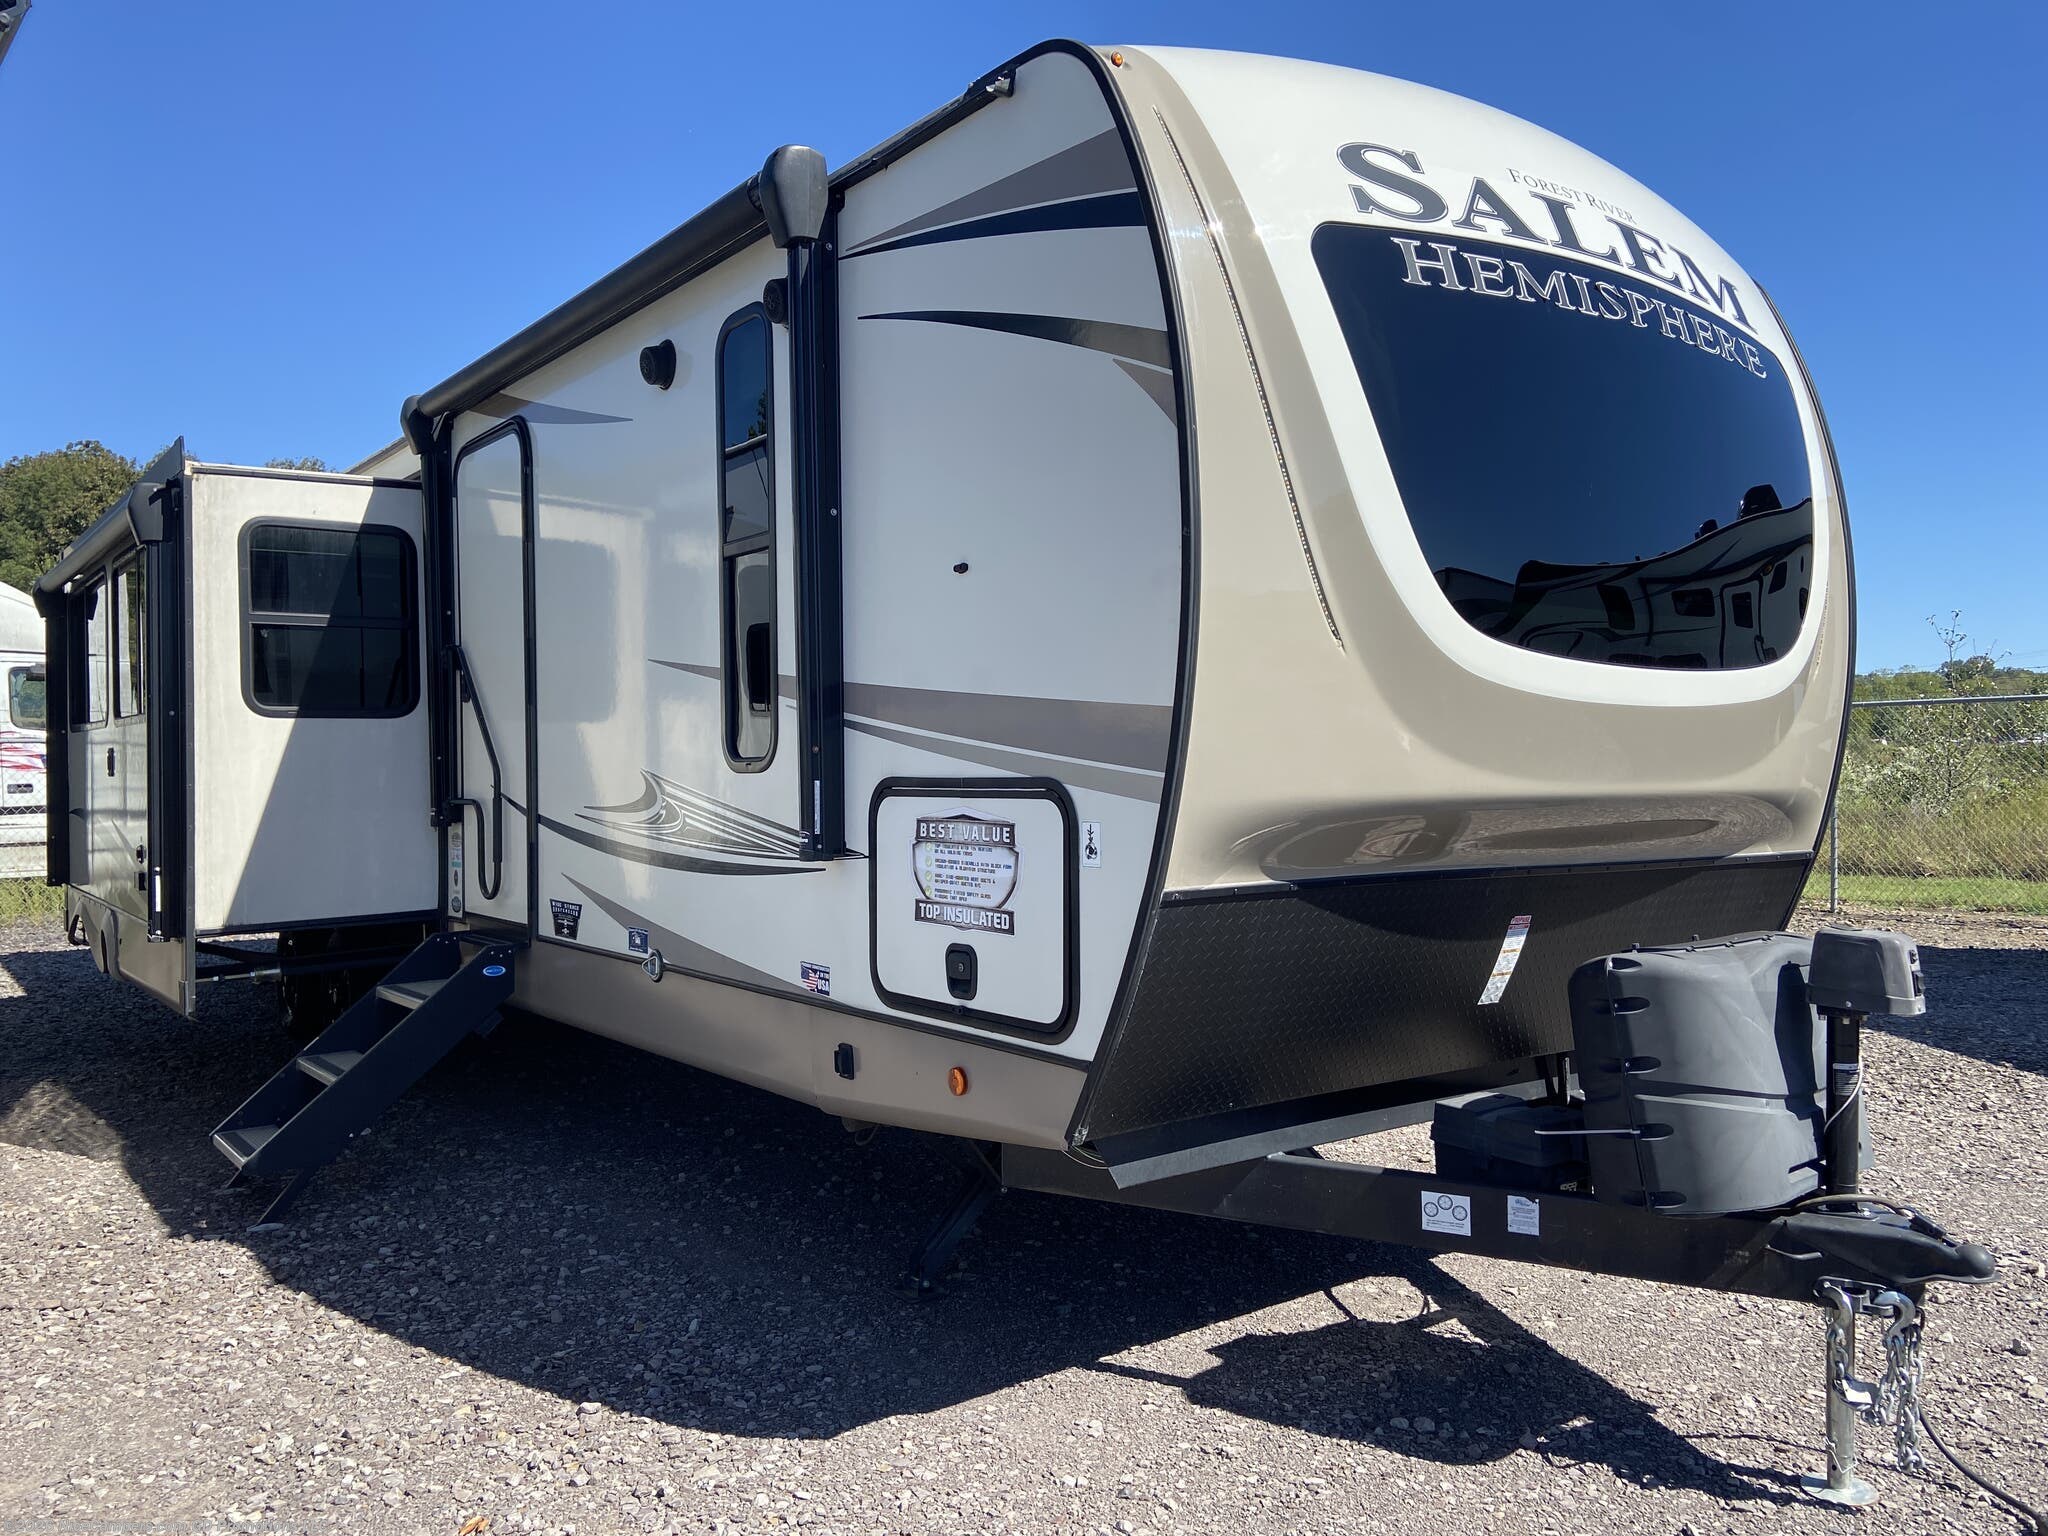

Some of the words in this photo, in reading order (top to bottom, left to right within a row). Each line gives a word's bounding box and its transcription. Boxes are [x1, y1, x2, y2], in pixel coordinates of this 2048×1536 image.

[1506, 168, 1581, 202] FOREST
[1583, 191, 1638, 225] RIVER
[1336, 141, 1759, 335] SALEM
[1390, 236, 1768, 379] HEMISPHERE
[919, 822, 955, 840] BEST
[962, 825, 1011, 843] VALUE
[919, 902, 940, 919] TOP
[943, 906, 1010, 930] INSULATED
[817, 979, 830, 992] USA
